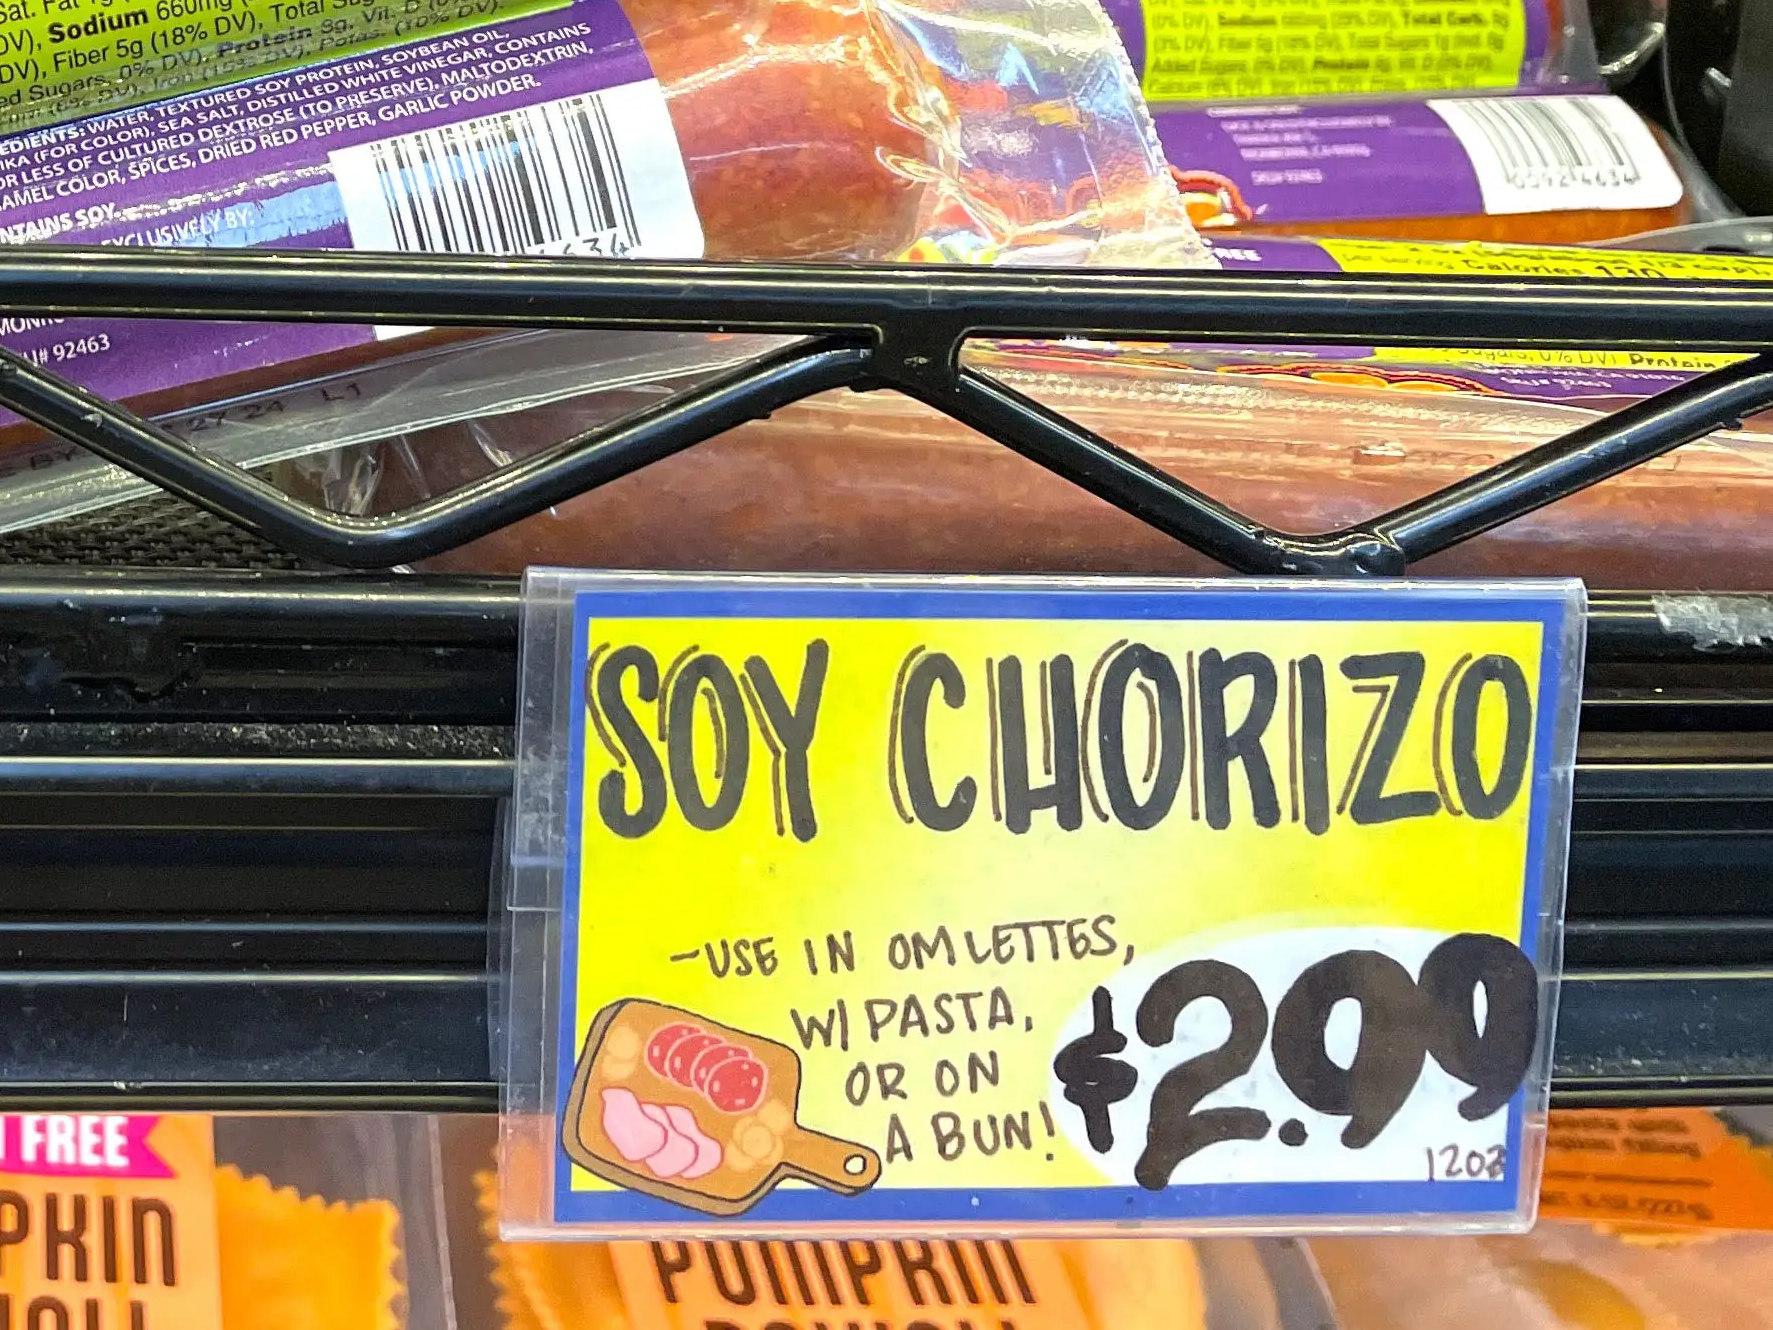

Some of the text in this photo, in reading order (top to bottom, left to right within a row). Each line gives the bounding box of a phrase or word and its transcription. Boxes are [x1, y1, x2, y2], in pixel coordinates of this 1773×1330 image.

[48, 9, 148, 43] Sodium
[53, 46, 108, 72] Fiber
[151, 22, 207, 54] (18%
[21, 162, 64, 183] LESS
[67, 155, 92, 171] OF
[97, 132, 194, 164] CULTURED
[197, 108, 296, 142] DEXTROSE
[299, 100, 332, 119] (TO
[335, 77, 439, 112] PRESERVE),
[441, 41, 592, 86] MALTODEXTRIN,
[34, 143, 77, 163] (FOR
[80, 126, 154, 150] COLOR),
[157, 116, 193, 132] SEA
[196, 104, 244, 123] SALT,
[246, 82, 338, 111] DISTILLED
[340, 67, 402, 88] WHITE
[402, 47, 492, 74] VINEGAR,
[494, 22, 590, 53] CONTAINS
[86, 111, 153, 133] WATER,
[154, 87, 250, 116] TEXTURED
[254, 77, 290, 94] SOY
[295, 59, 379, 85] PROTEIN,
[381, 37, 469, 64] SOYBEAN
[472, 30, 509, 43] OIL,
[56, 169, 125, 195] COLOR,
[128, 152, 195, 179] SPICES,
[197, 138, 256, 163] DRIED
[259, 128, 297, 149] RED
[300, 111, 376, 138] PEPPER,
[378, 93, 448, 120] GARLIC
[450, 74, 540, 104] POWDER.
[52, 333, 109, 360] 92463
[584, 638, 1534, 843] SOY CHORIZO
[803, 929, 856, 976] IN
[888, 914, 1135, 970] OMLETTES,
[791, 999, 849, 1052] W/
[844, 1050, 1000, 1107] OR ON
[1054, 932, 1539, 1191] $2.99
[20, 1114, 130, 1168] FREE
[886, 1100, 1058, 1165] A BUN!
